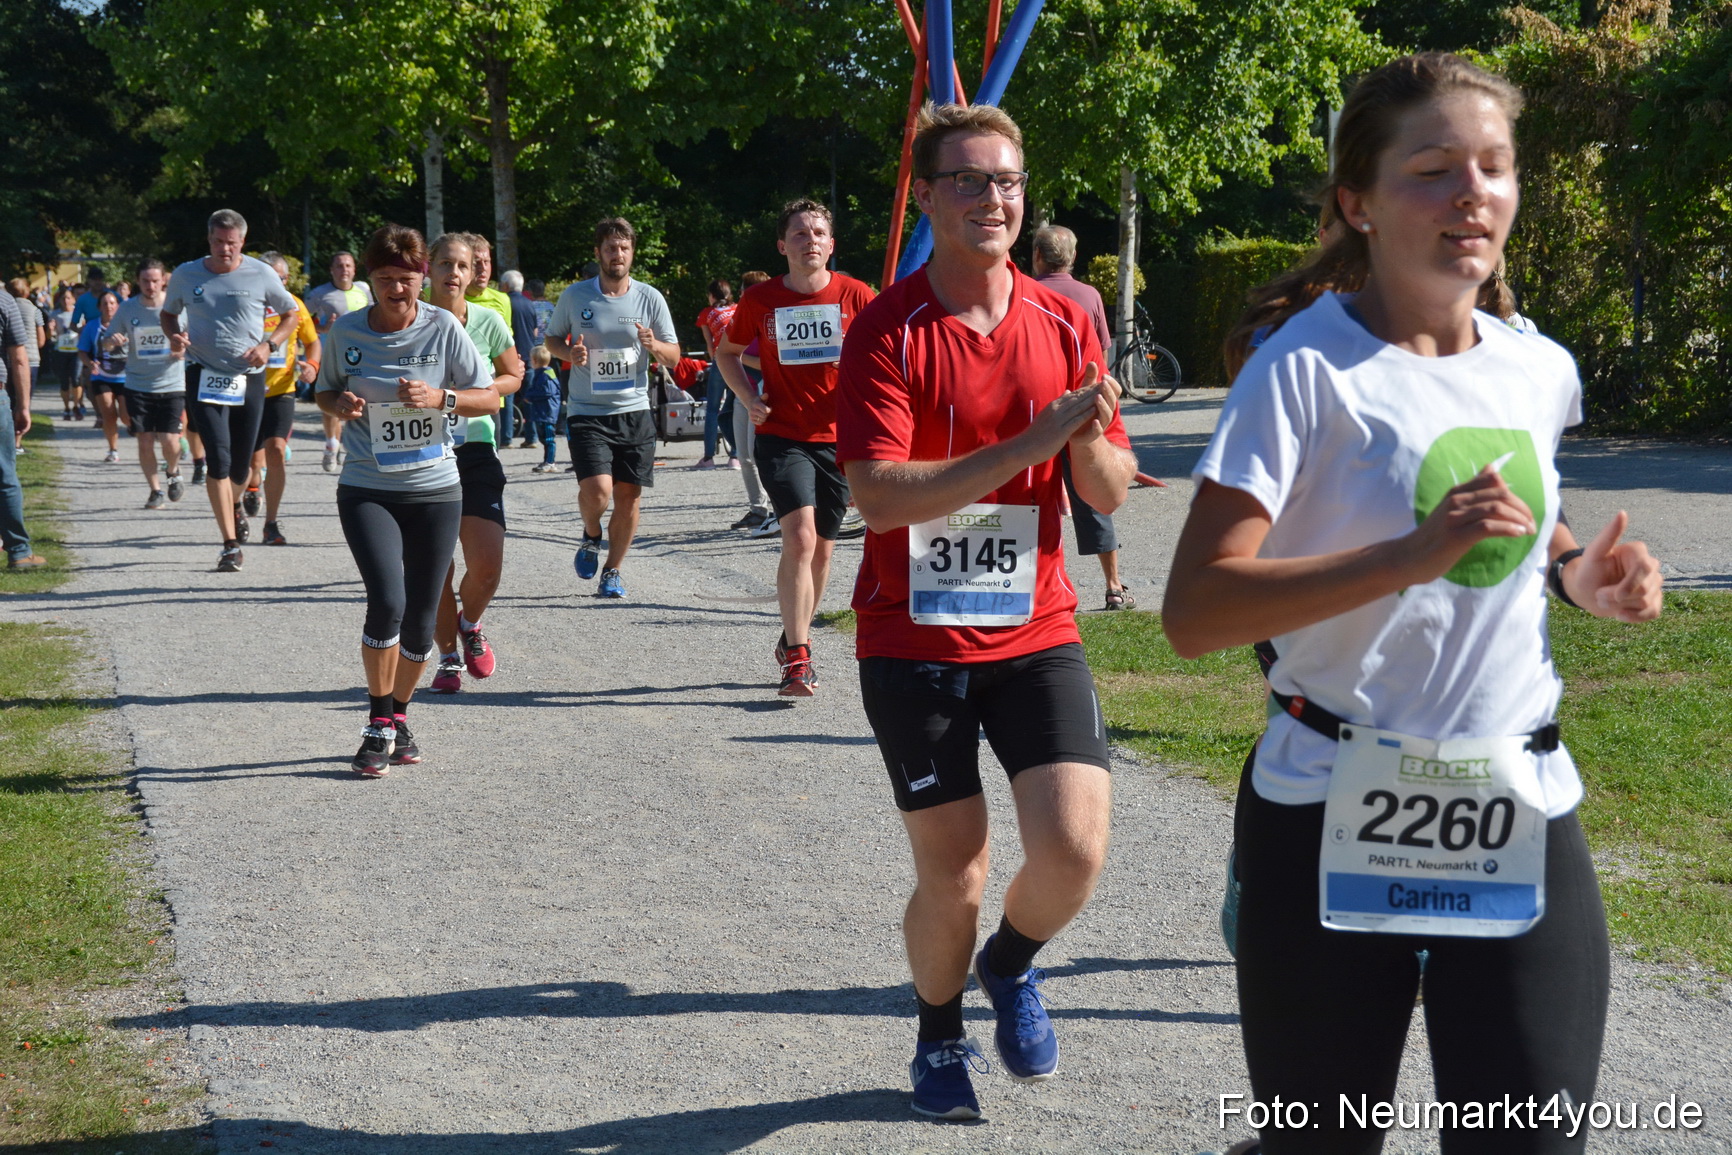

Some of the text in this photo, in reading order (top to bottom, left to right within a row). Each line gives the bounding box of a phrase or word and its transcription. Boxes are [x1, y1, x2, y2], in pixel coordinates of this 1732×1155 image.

[793, 310, 822, 319] BOCK
[786, 320, 832, 341] 2016
[140, 334, 165, 346] 2422
[398, 354, 439, 366] BOCK
[798, 349, 824, 358] Martin
[597, 361, 629, 376] 3011
[206, 376, 239, 391] 2595
[382, 417, 433, 443] 3105
[947, 514, 1002, 528] BOCK
[929, 536, 1018, 574] 3145
[916, 564, 922, 572] D
[937, 578, 1000, 588] PARTL Neumarkt
[1399, 754, 1491, 779] BOCK
[1357, 788, 1516, 852] 2260
[1335, 828, 1344, 840] C
[1368, 854, 1478, 872] PARTL Neumarkt
[1387, 882, 1471, 912] Carina
